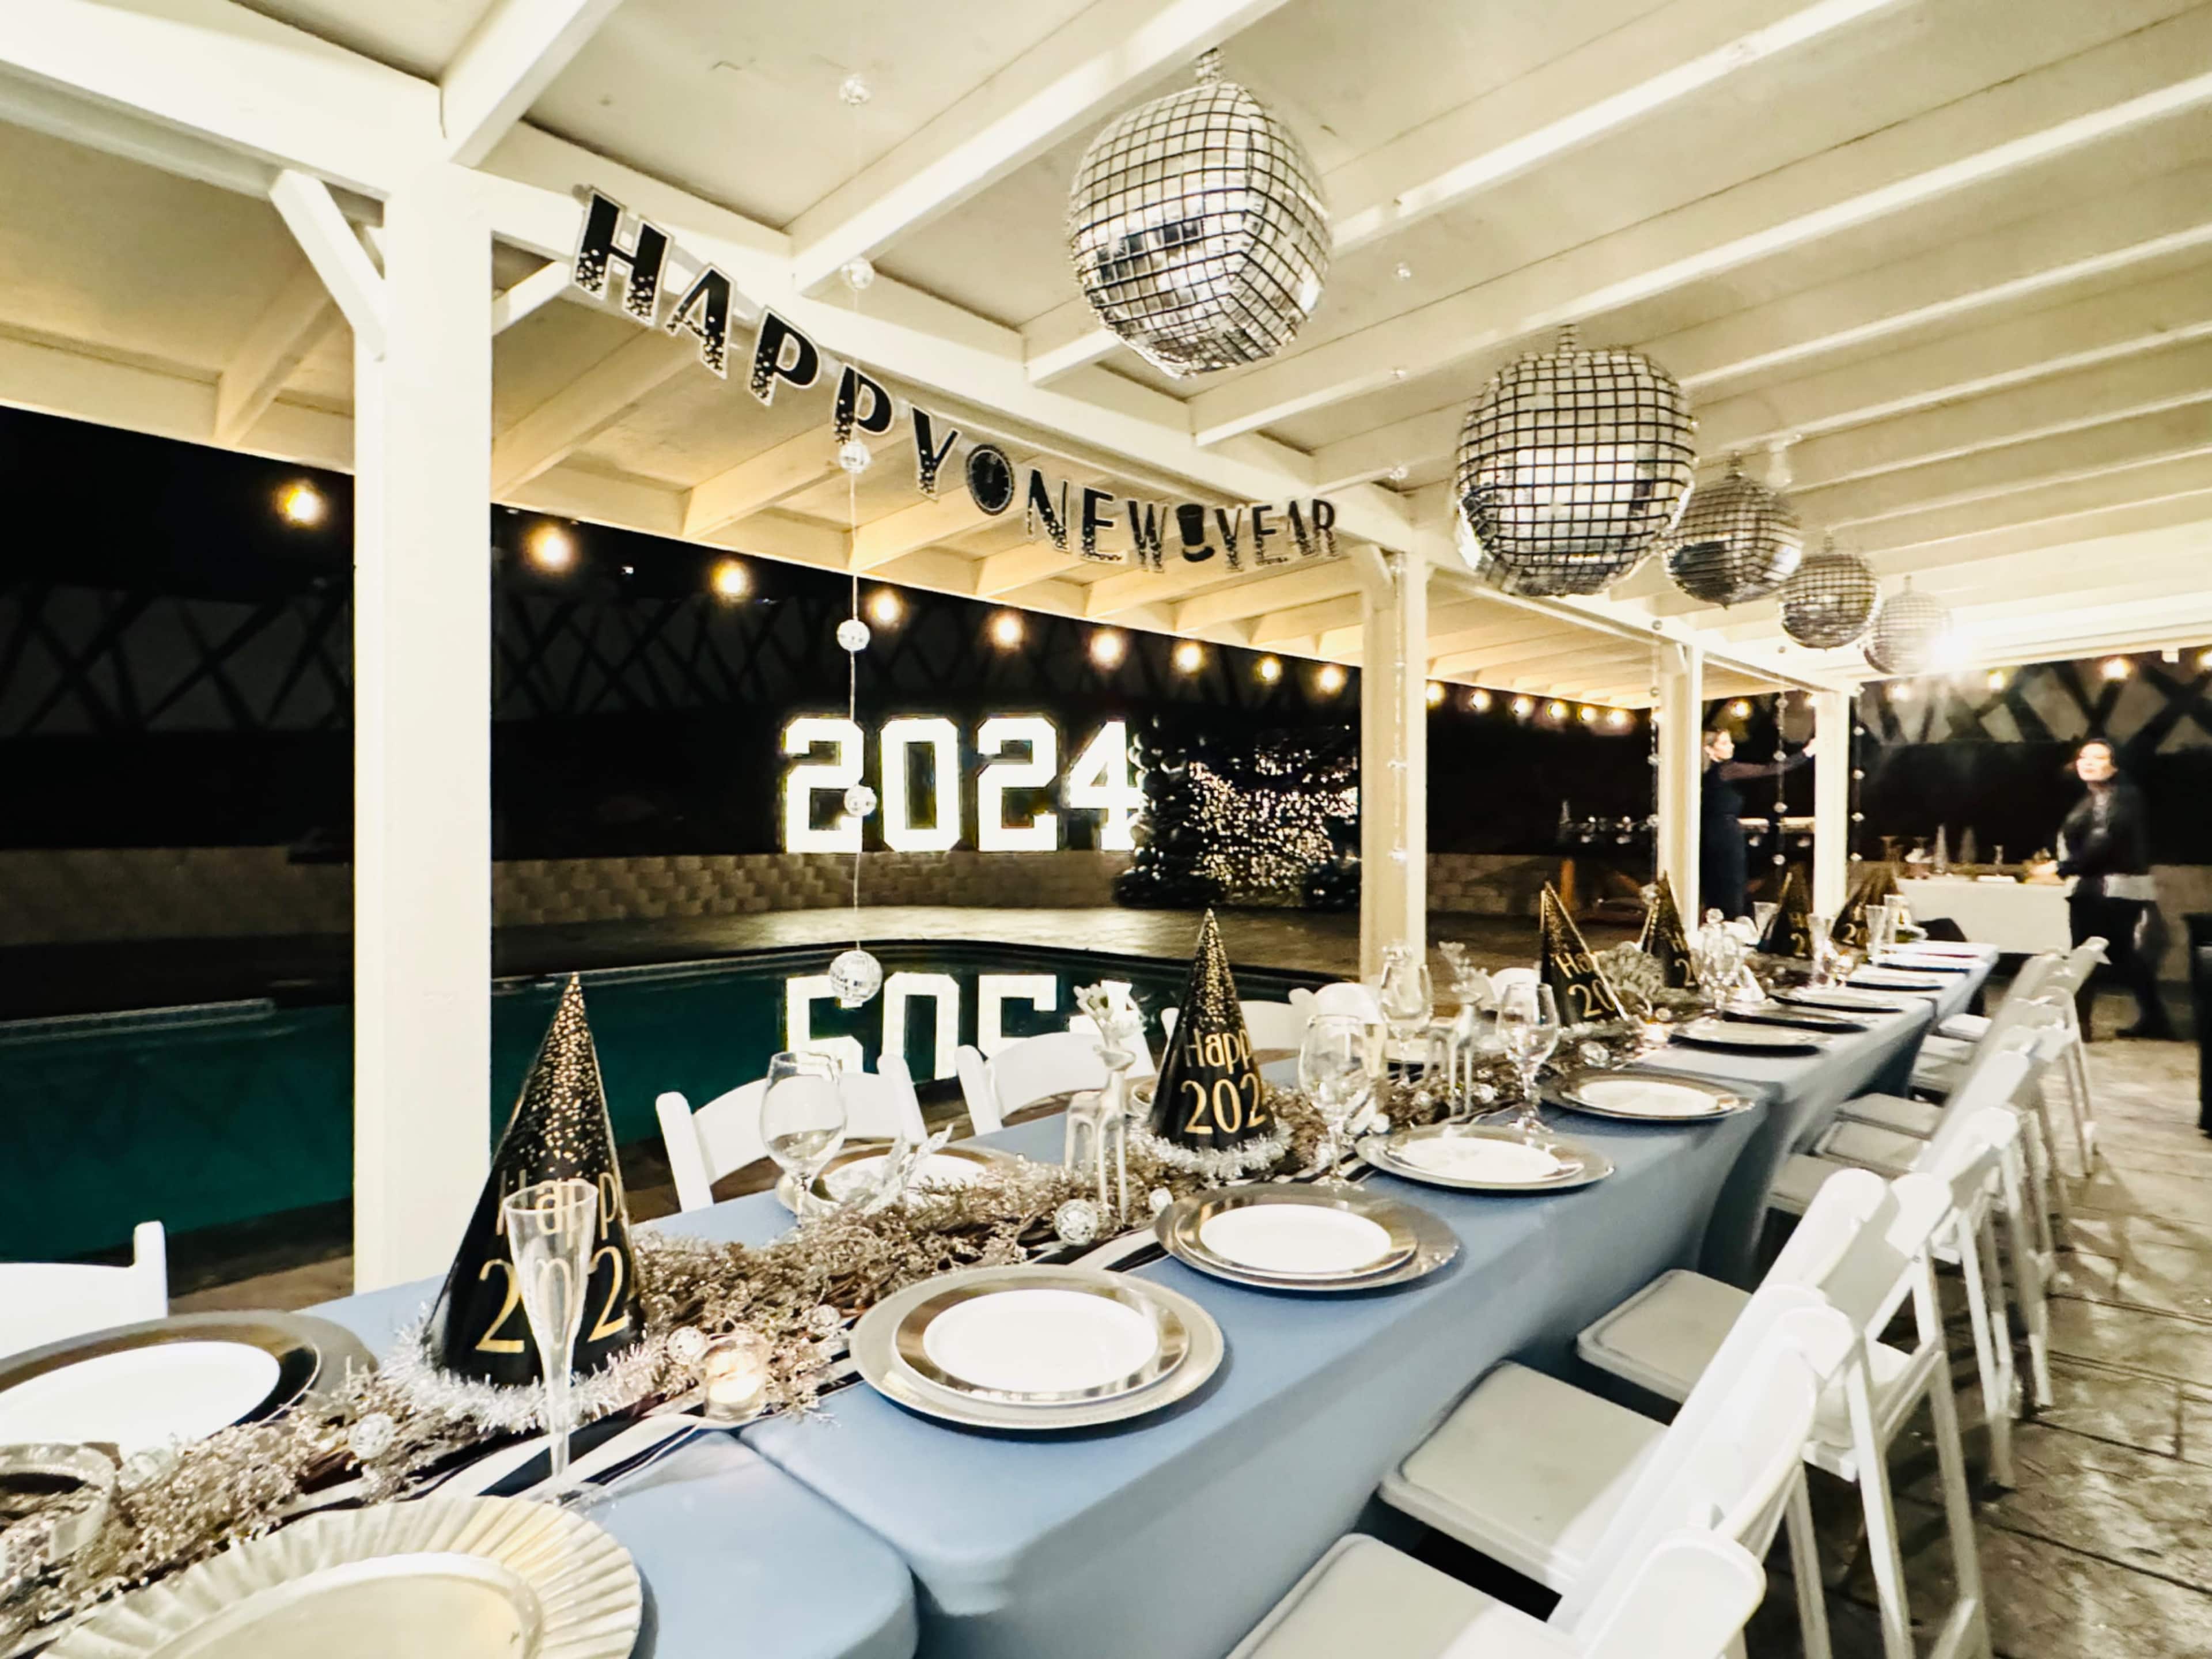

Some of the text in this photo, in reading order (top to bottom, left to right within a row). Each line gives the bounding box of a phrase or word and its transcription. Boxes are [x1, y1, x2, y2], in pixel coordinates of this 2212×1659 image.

[573, 189, 1339, 572] HAPPY NEW YEAR
[785, 717, 1145, 853] 2024
